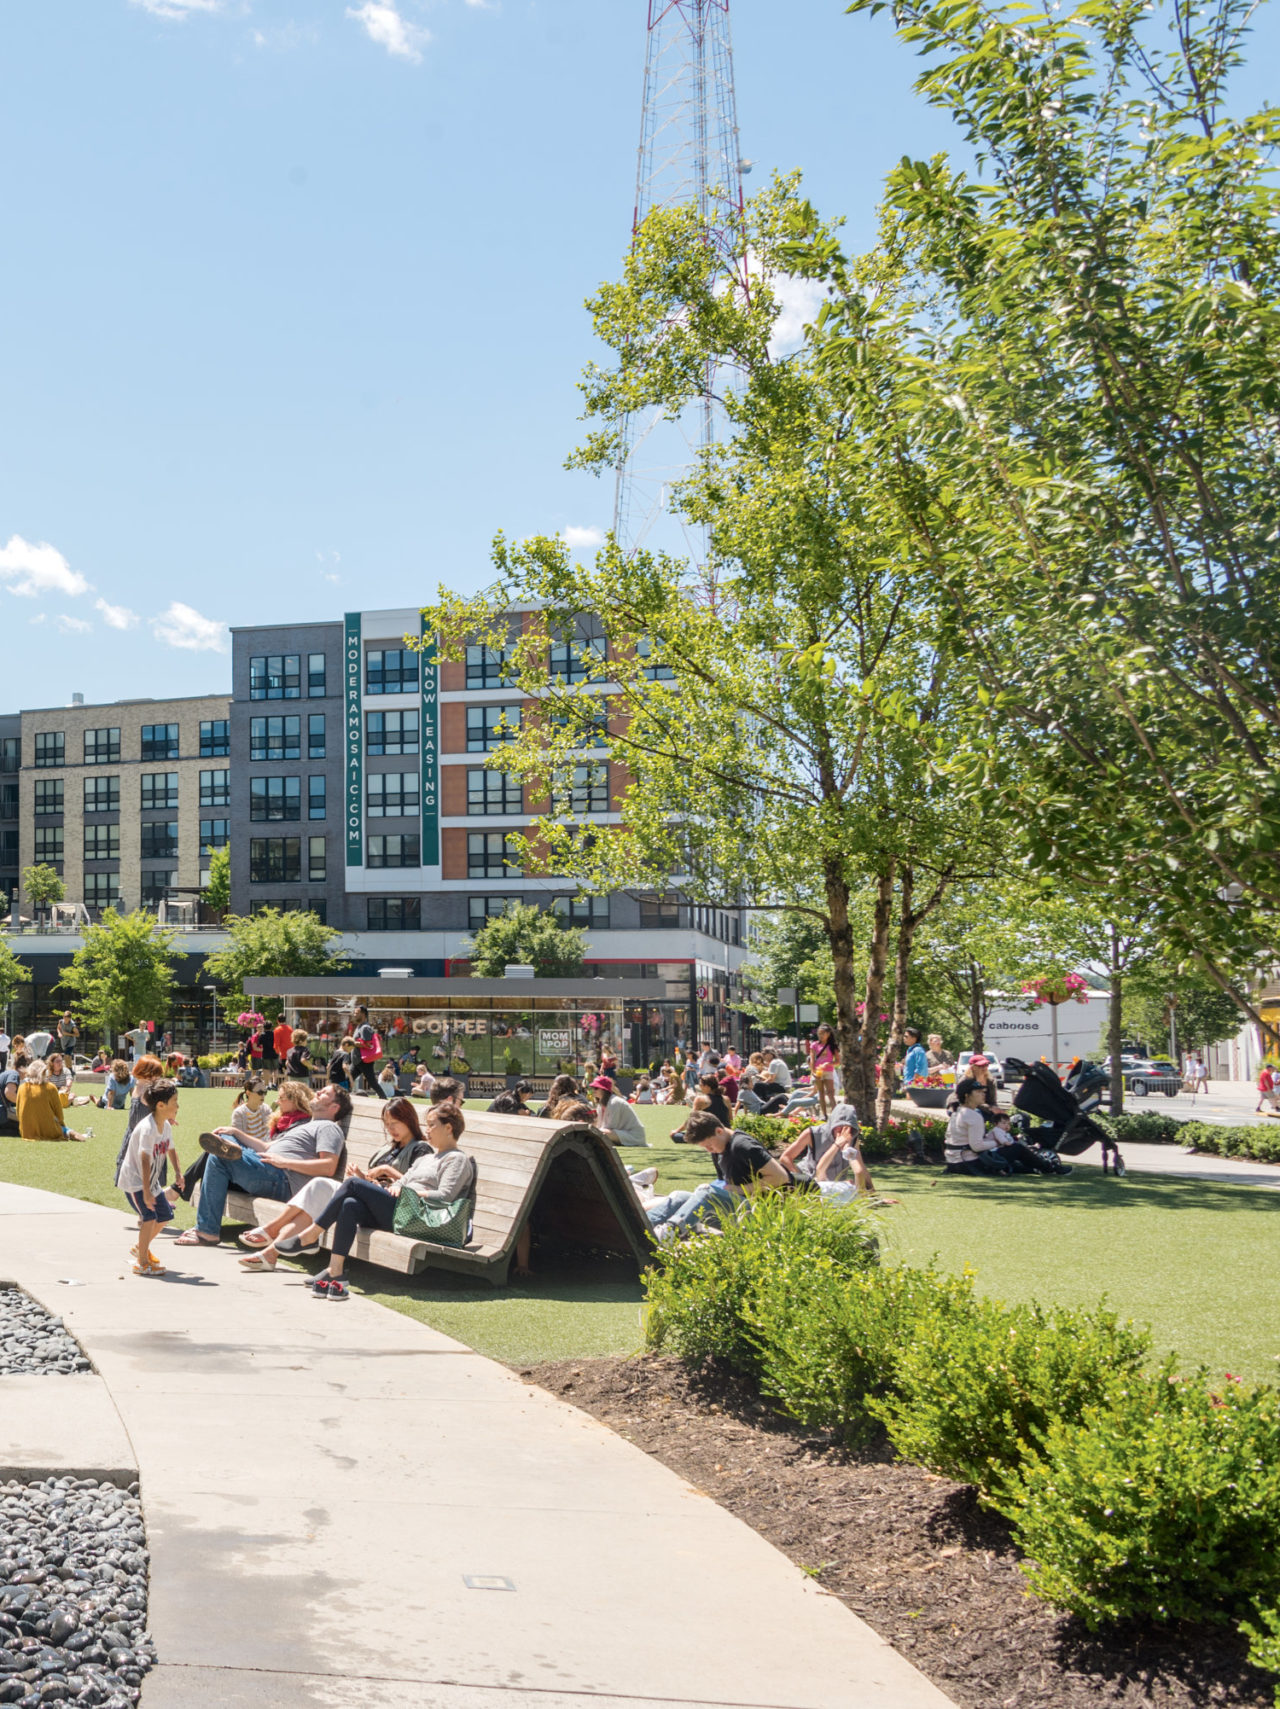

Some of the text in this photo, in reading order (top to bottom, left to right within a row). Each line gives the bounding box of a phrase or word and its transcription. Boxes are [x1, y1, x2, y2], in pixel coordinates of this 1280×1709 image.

[423, 666, 436, 806] NOW LEASING
[412, 1018, 488, 1035] COFFEE
[989, 1021, 1039, 1030] caboose
[542, 1032, 569, 1040] MOM
[547, 1040, 568, 1048] POP
